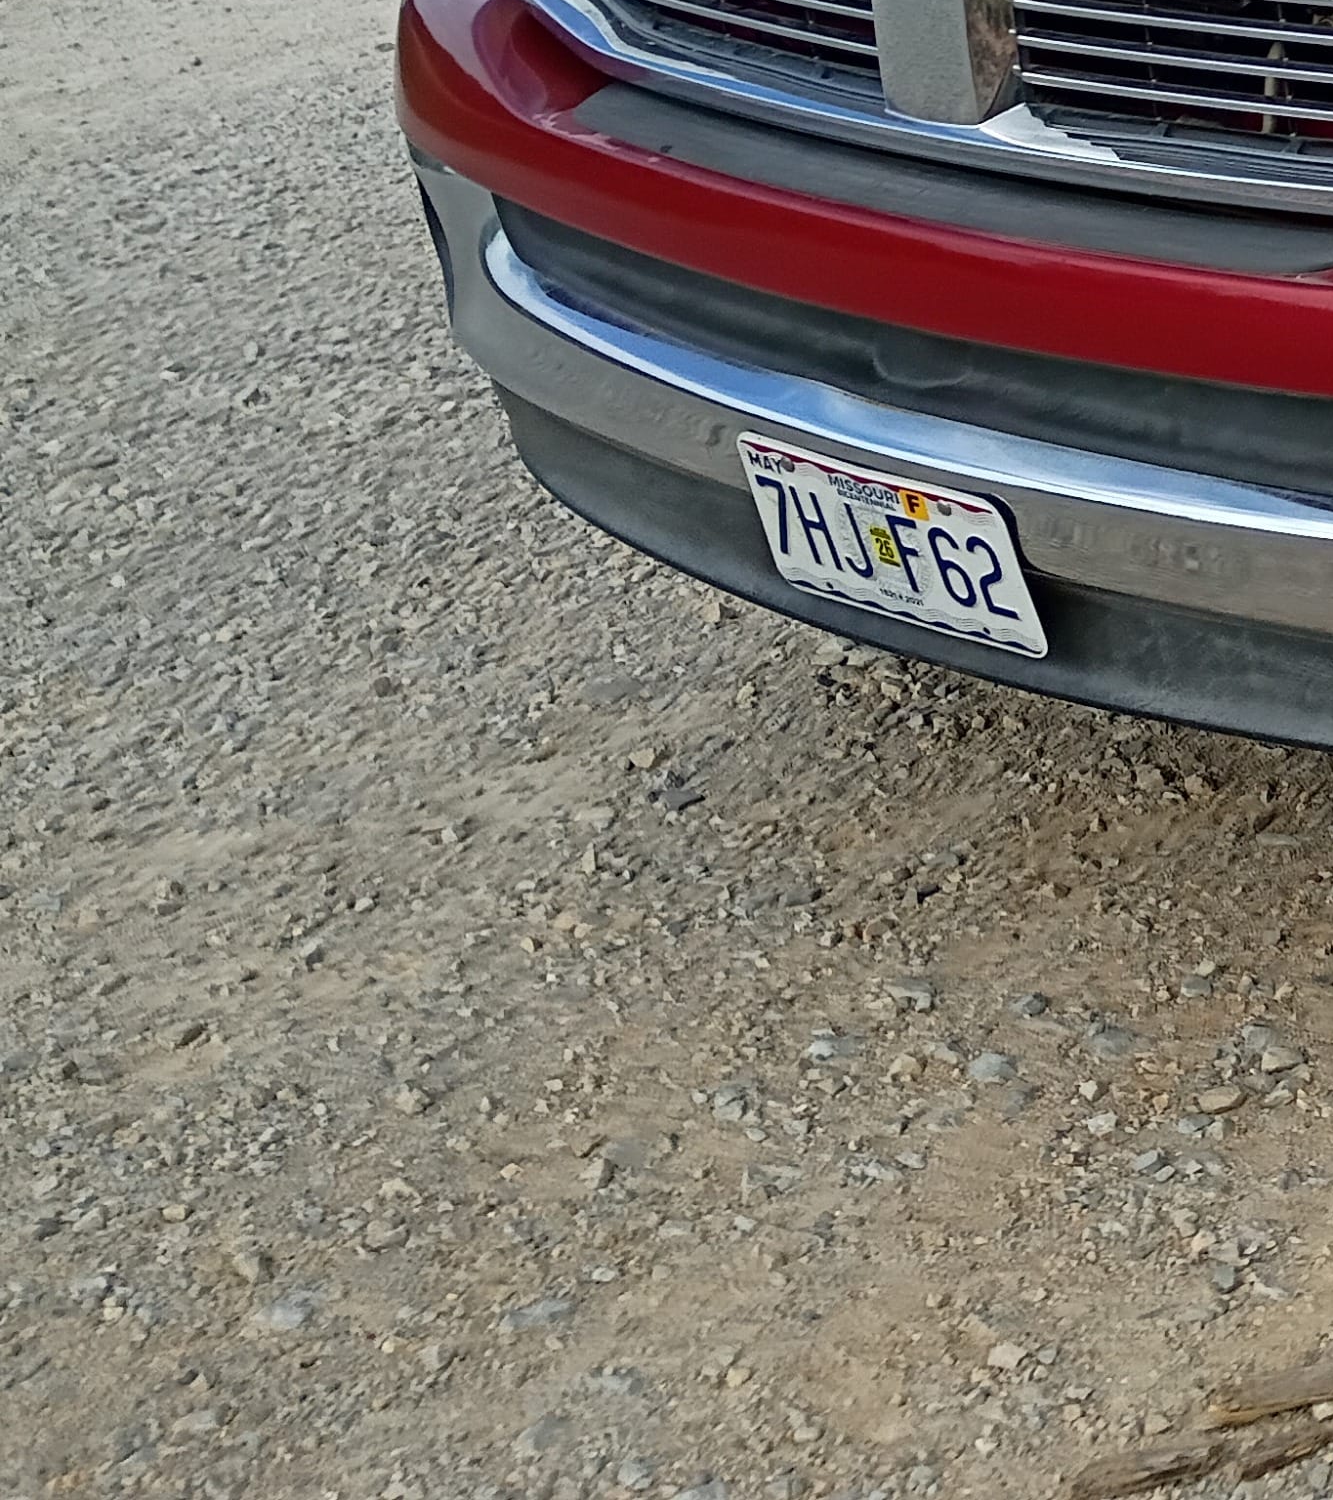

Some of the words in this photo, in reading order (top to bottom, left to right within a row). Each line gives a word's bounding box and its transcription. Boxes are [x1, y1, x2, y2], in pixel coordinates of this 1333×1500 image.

[747, 451, 783, 475] MAY
[827, 474, 900, 505] MISSOURI
[905, 493, 920, 514] F
[875, 537, 895, 560] 26
